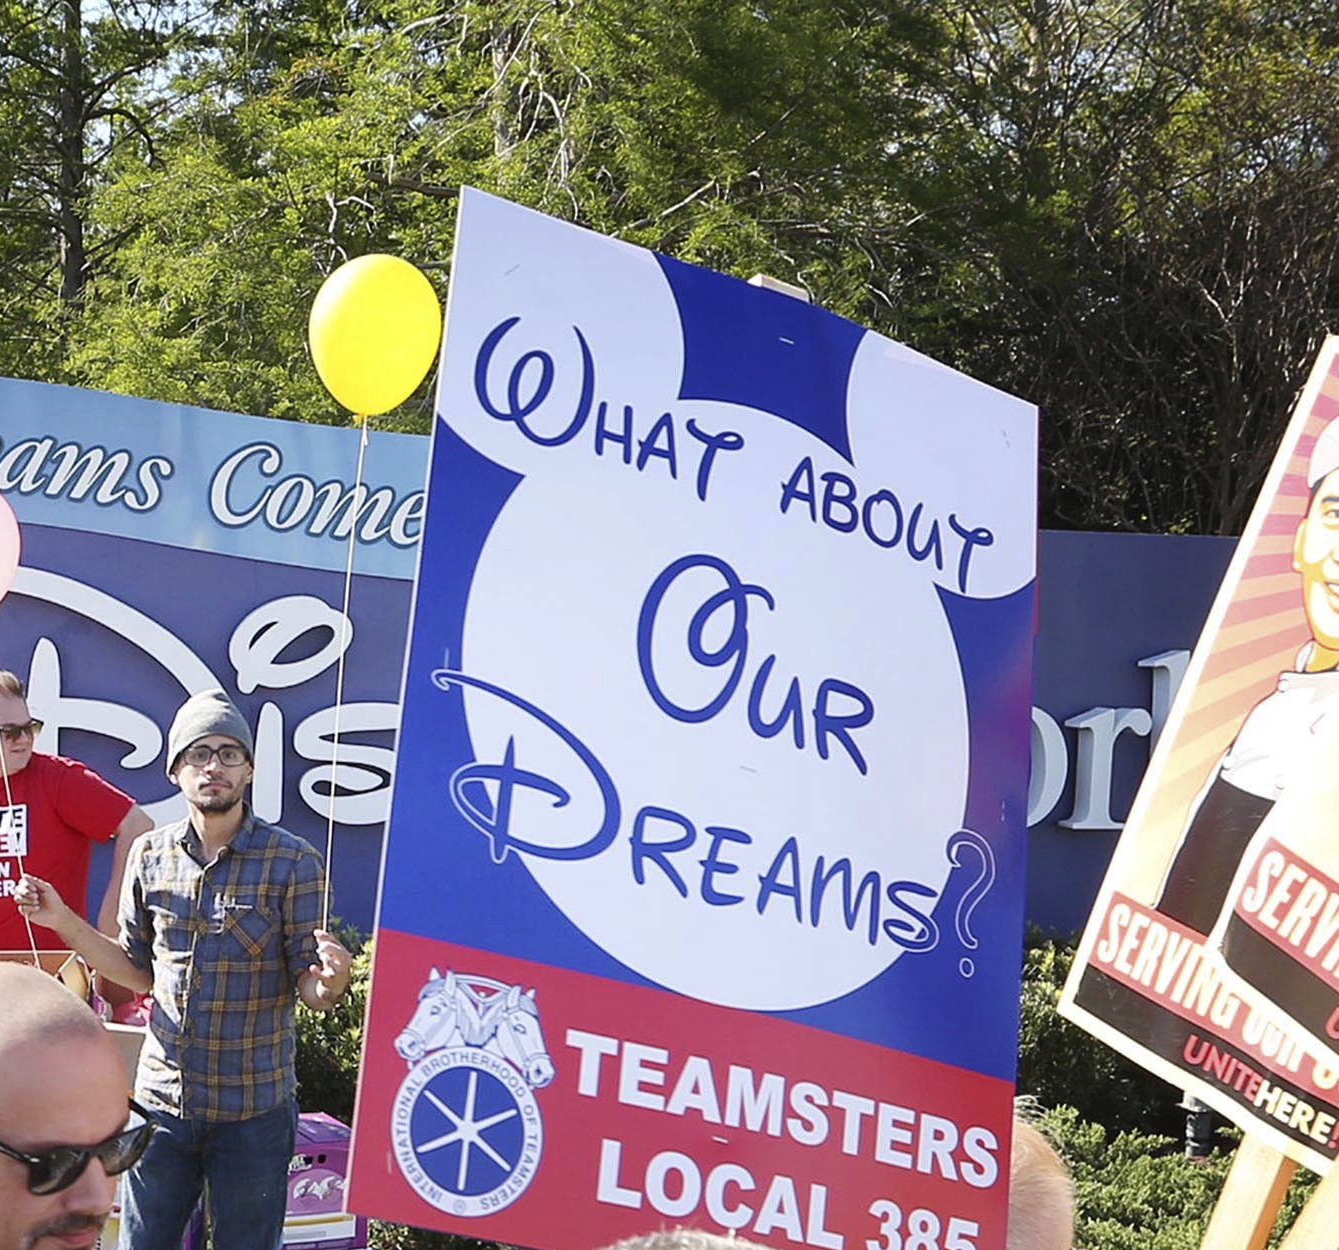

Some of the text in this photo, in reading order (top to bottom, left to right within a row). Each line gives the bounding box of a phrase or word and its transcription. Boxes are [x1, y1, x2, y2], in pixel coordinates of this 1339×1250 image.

[208, 441, 424, 549] Come
[474, 316, 994, 595] WHAT ABOUT
[636, 552, 875, 776] OUR
[430, 667, 997, 979] DREAMS?
[421, 1051, 526, 1099] BROTHERHOOD
[564, 1028, 1000, 1190] TEAMSTERS
[596, 1140, 844, 1250] LOCAL
